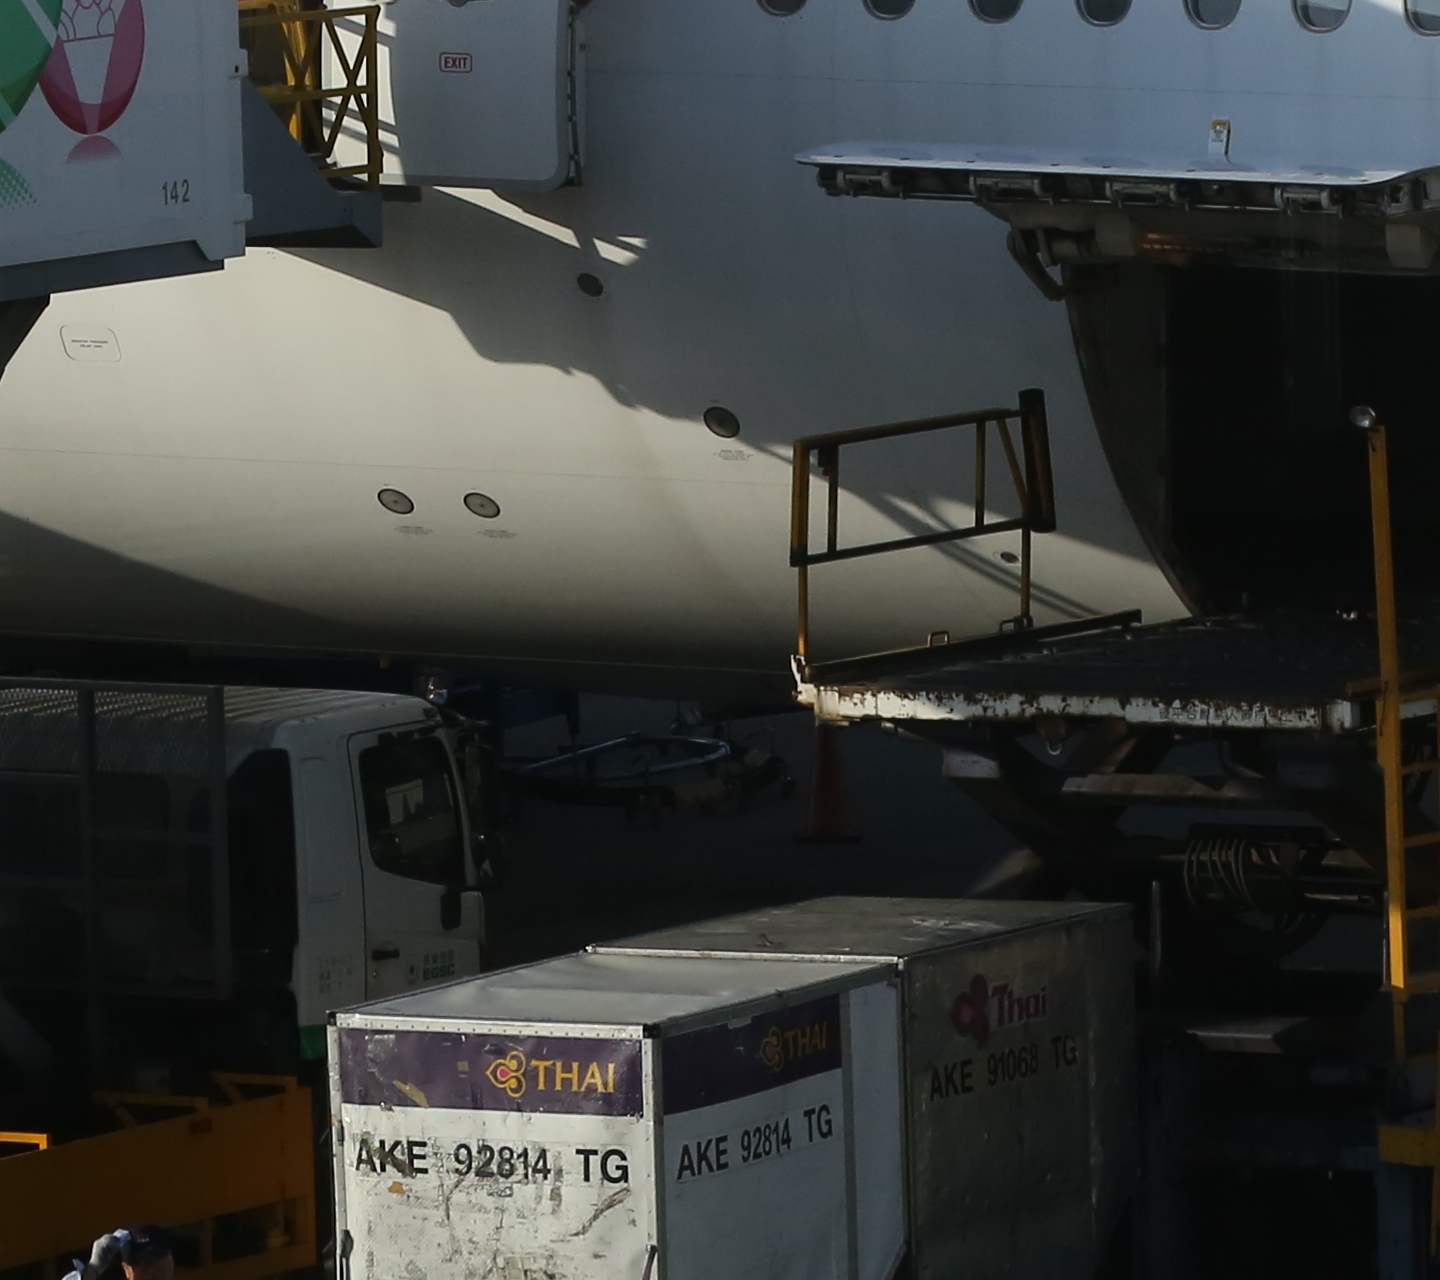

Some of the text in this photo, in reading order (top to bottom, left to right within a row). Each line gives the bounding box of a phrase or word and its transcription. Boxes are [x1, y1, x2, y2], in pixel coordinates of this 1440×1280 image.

[444, 56, 469, 69] EXIT
[162, 179, 190, 205] 142
[991, 984, 1048, 1028] Thai
[783, 1021, 827, 1063] THAI
[529, 1059, 616, 1094] THAI
[929, 1034, 1079, 1103] AKE 91068 TG
[355, 1137, 629, 1185] AKE 92814 TG
[676, 1103, 834, 1181] AKE 92814 TG
